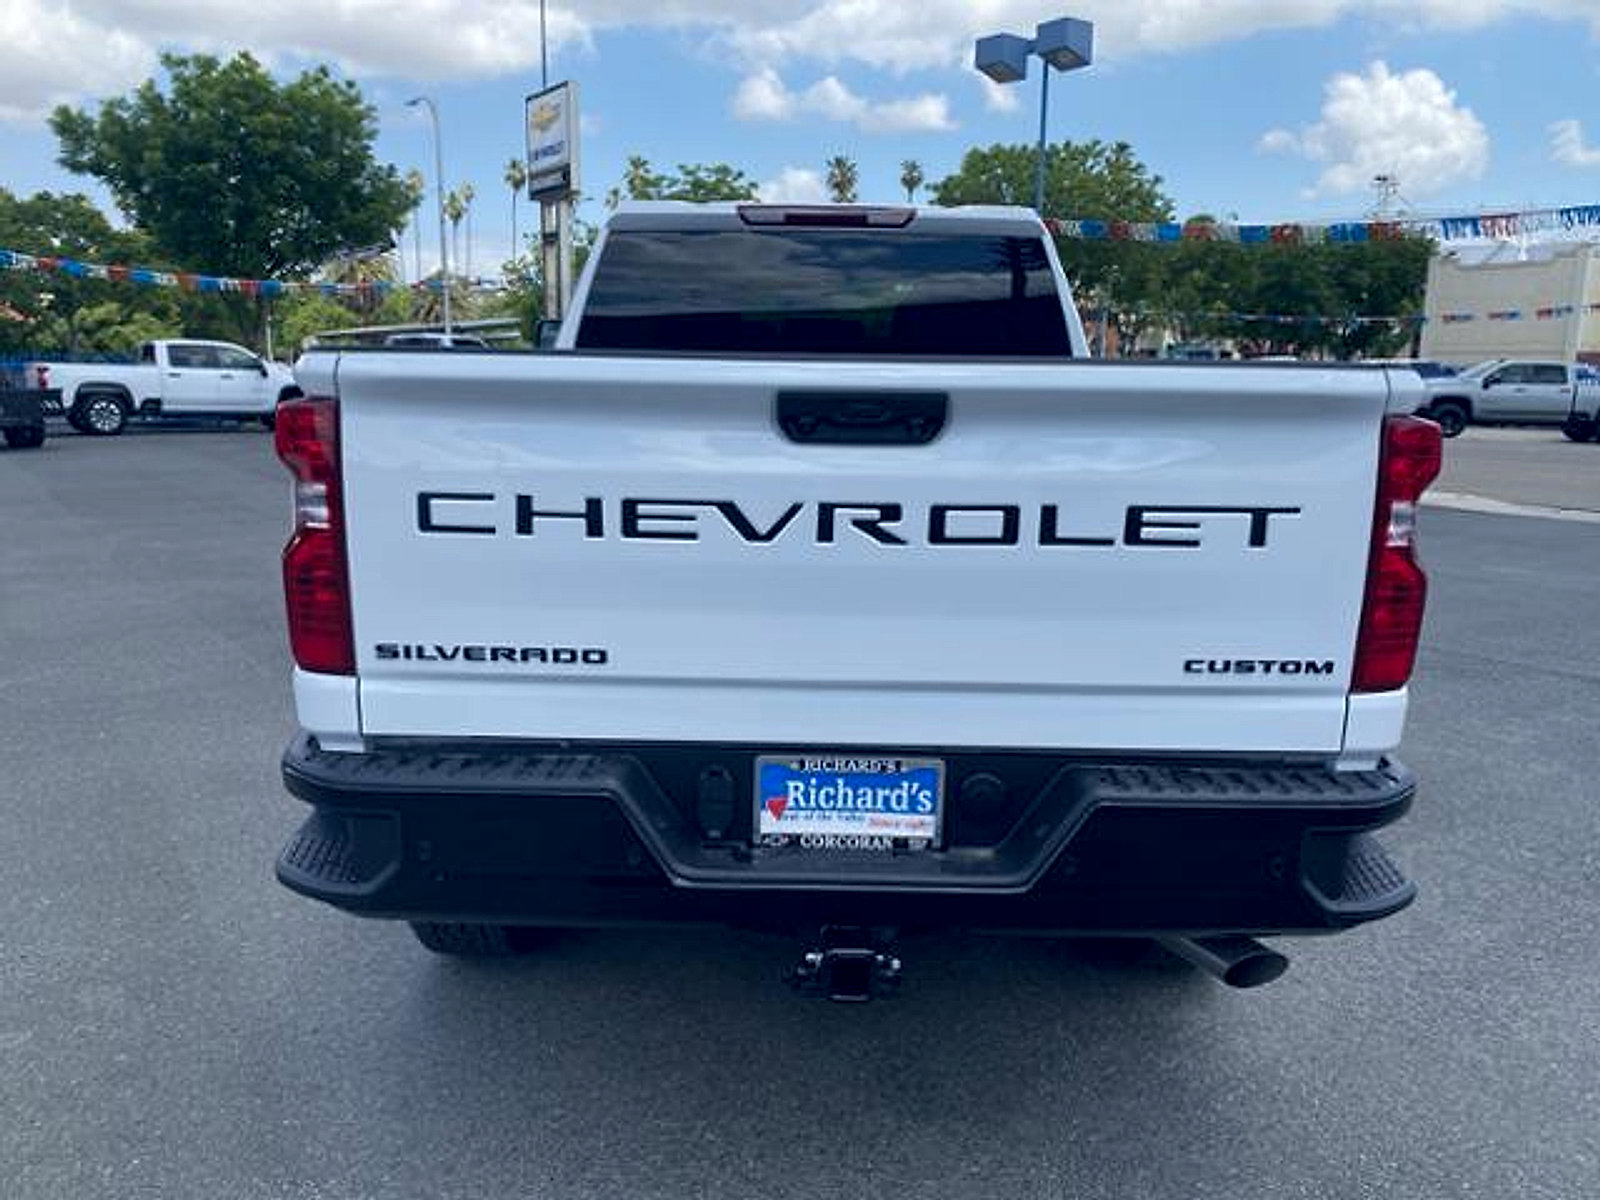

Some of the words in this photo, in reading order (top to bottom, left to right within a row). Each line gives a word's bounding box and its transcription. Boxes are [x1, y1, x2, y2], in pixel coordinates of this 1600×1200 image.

[418, 492, 1301, 547] CHEVROLET
[376, 644, 607, 664] SILVERADO
[1184, 660, 1334, 674] CUSTOM
[803, 760, 897, 774] RICHARD'S
[785, 777, 932, 813] Richard's
[800, 835, 894, 850] CORCORAN
